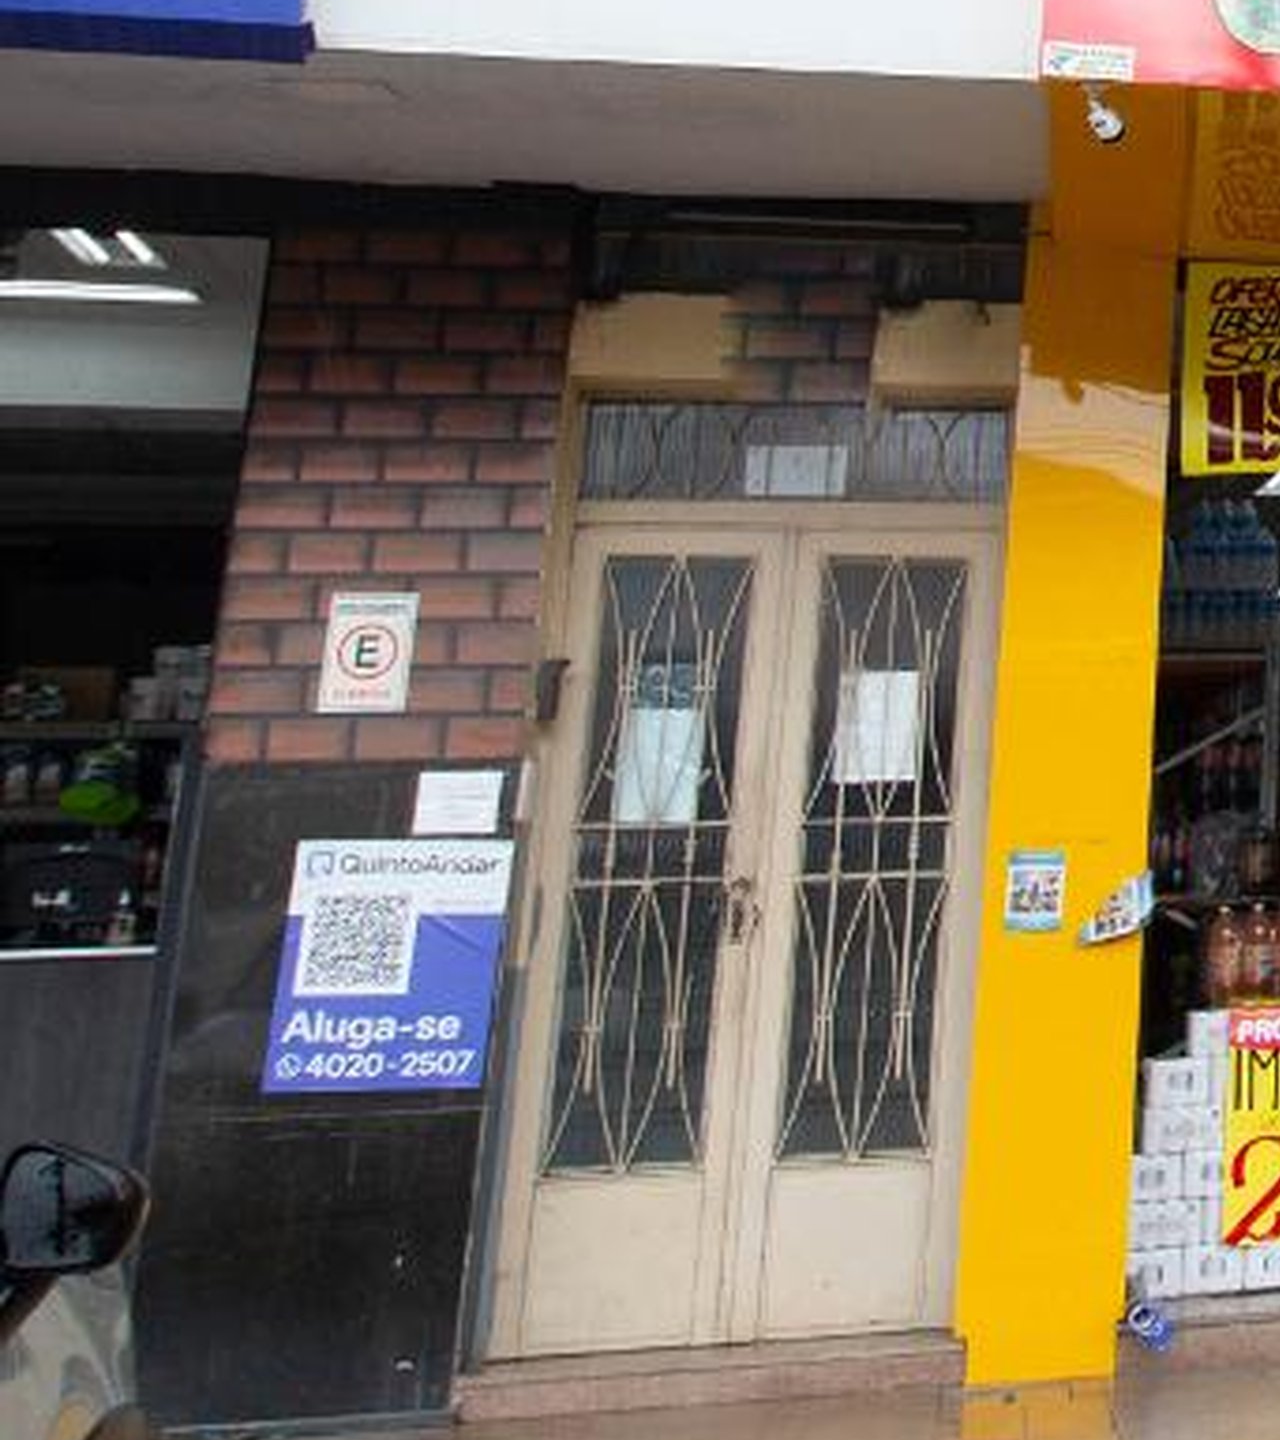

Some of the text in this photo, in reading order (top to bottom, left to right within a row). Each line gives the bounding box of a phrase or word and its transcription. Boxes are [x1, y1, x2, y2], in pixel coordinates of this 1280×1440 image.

[355, 634, 380, 668] E
[340, 853, 501, 876] QuintoAndar
[281, 1011, 462, 1050] Aluga-se
